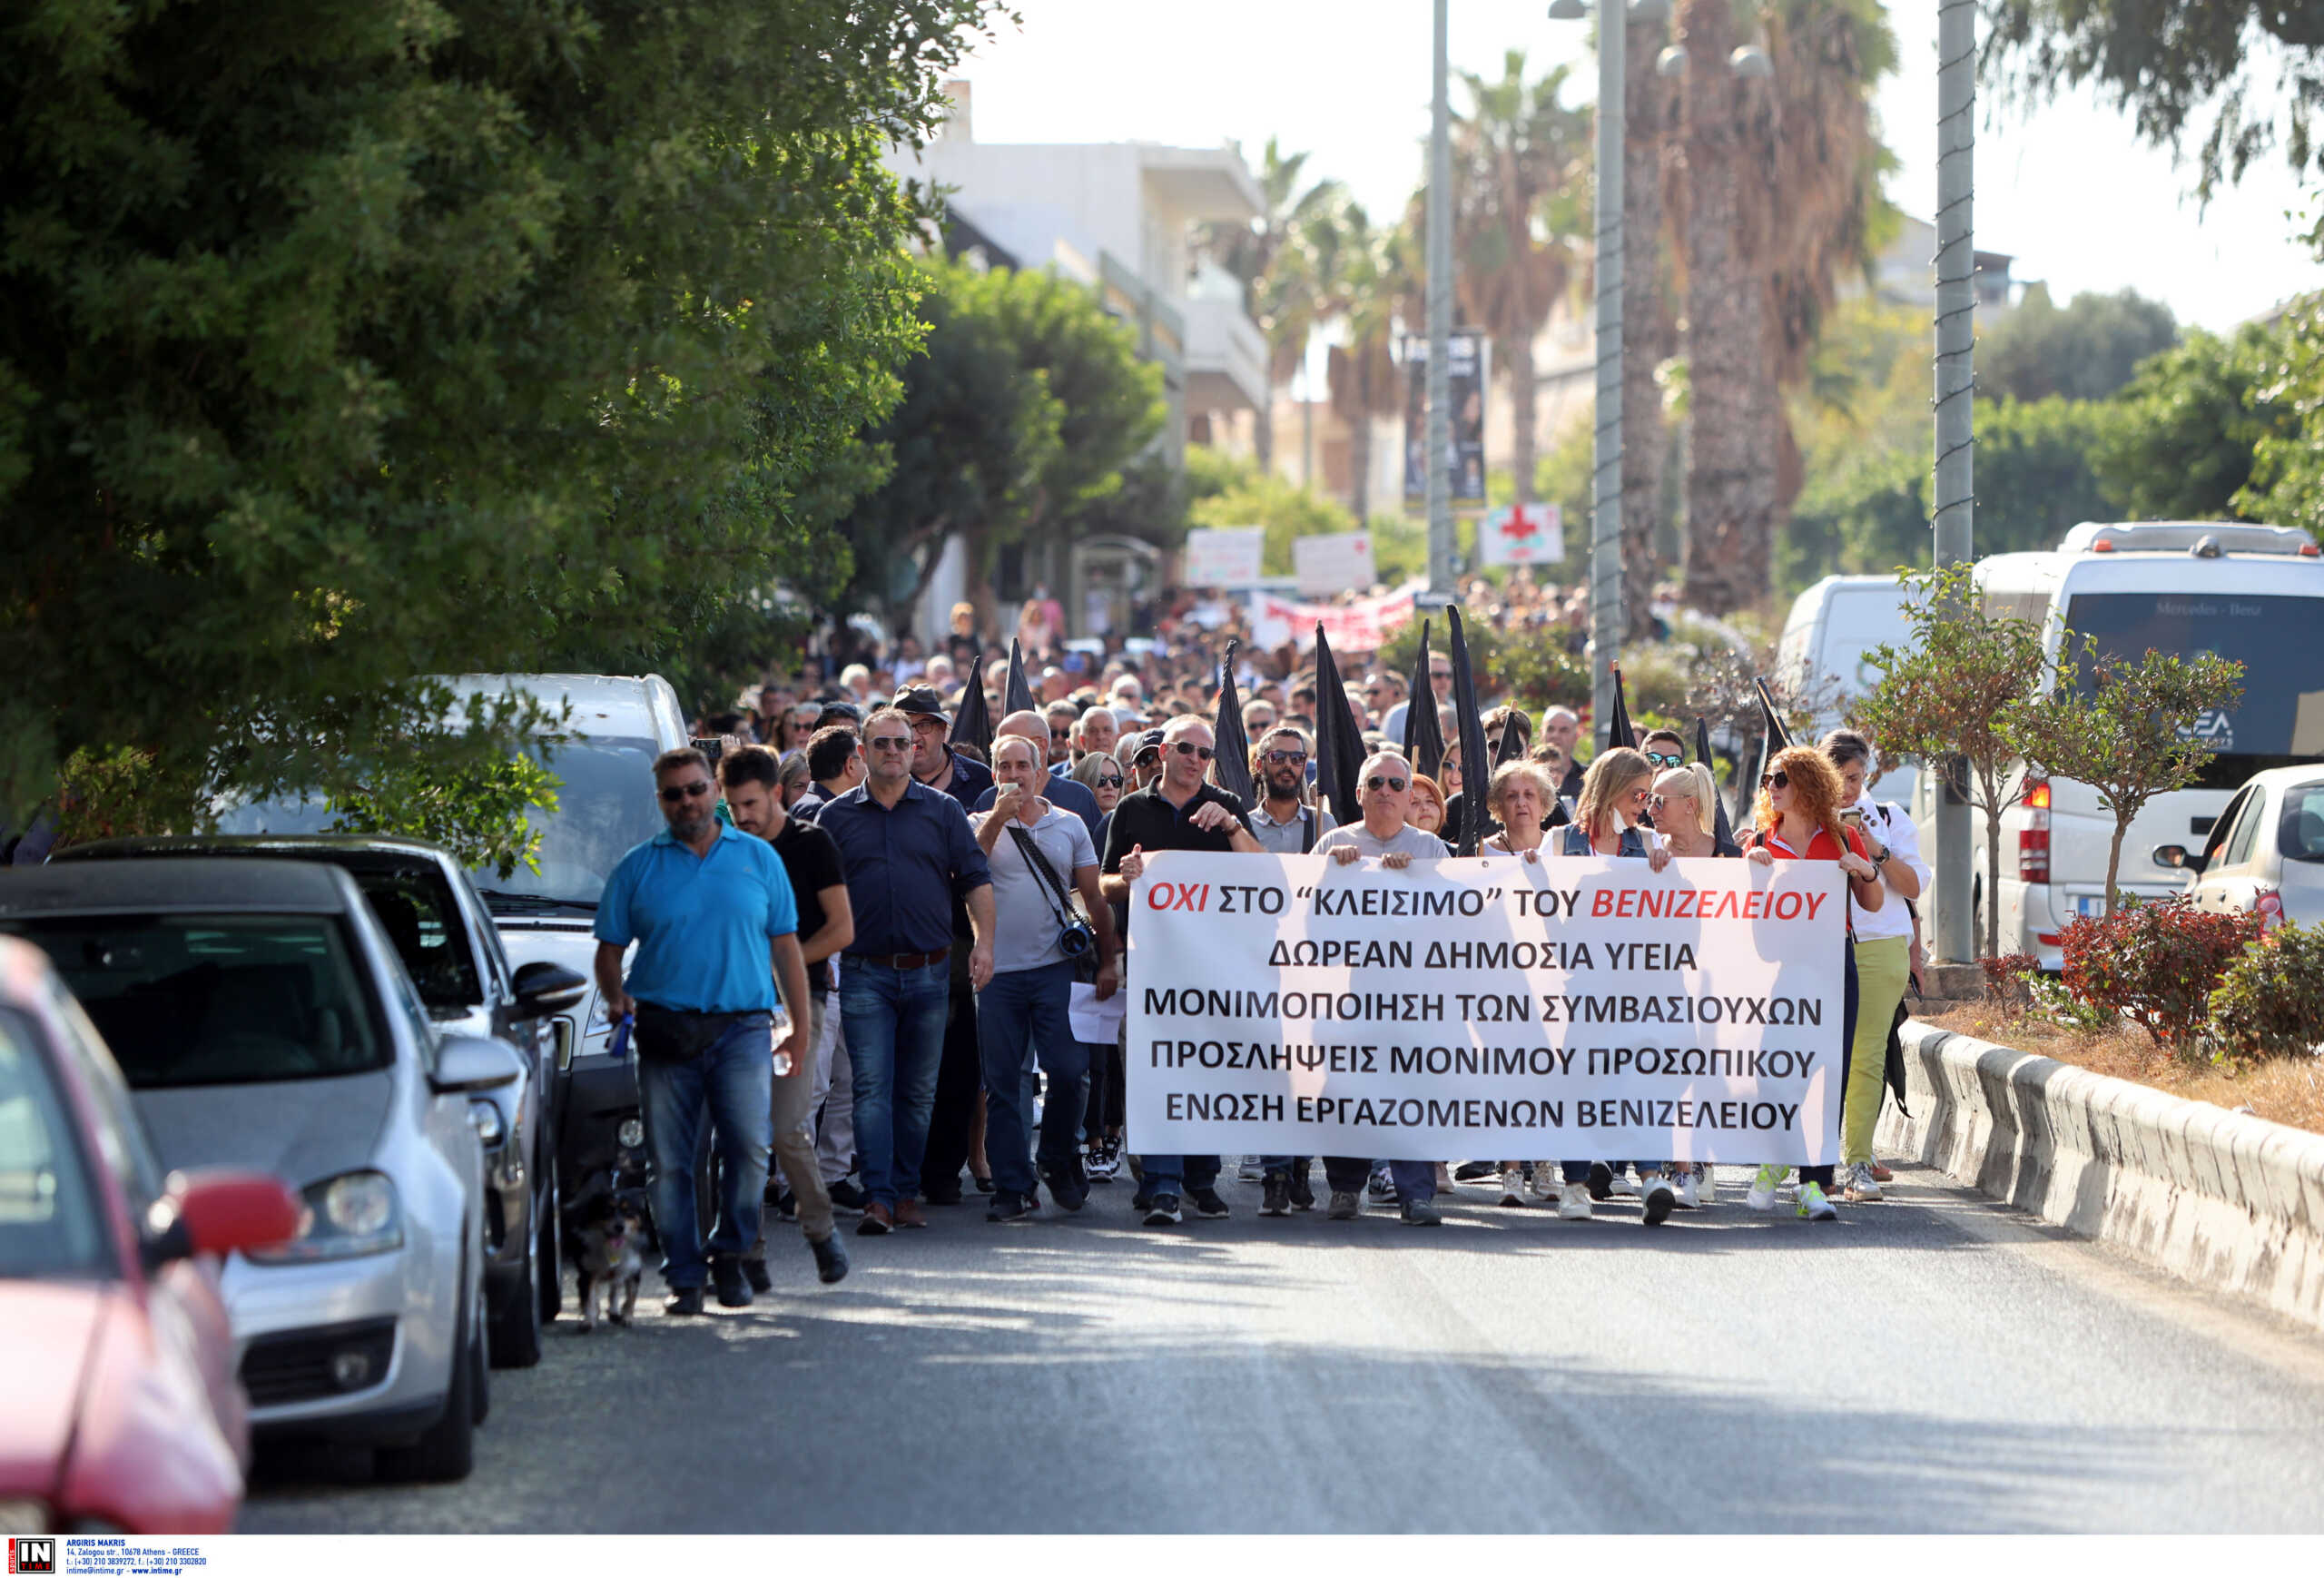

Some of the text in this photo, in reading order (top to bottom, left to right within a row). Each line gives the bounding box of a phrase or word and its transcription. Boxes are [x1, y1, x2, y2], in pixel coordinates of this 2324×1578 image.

[2155, 602, 2217, 616] Mercedes
[2229, 603, 2262, 617] Benz
[1147, 882, 1828, 921] ΟΧΙ ΣΤΟ “ΚΛΕΙΣΙΜΟ” ΤΟΥ ΒΕΝΙΖΕΛΕΙΟΥ
[1268, 940, 1698, 971] ΔΩΡΕΑΝ ΔΗΜΟΣΙΑ ΥΓΕΙΑ
[1144, 987, 1822, 1026] ΜΟΝΙΜΟΠΟΙΗΣΗ ΤΩΝ ΣΥΜΒΑΣΙΟΥΧΩΝ
[1151, 1040, 1817, 1079] ΠΡΟΣΛΗΨΕΙΣ ΜΟΝΙΜΟΥ ΠΡΟΣΩΠΙΚΟΥ
[1167, 1092, 1799, 1131] ΕΝΩΣΗ ΕΡΓΑΖΟΜΕΝΩΝ ΒΕΝΙΖΕΛΕΙΟΥ
